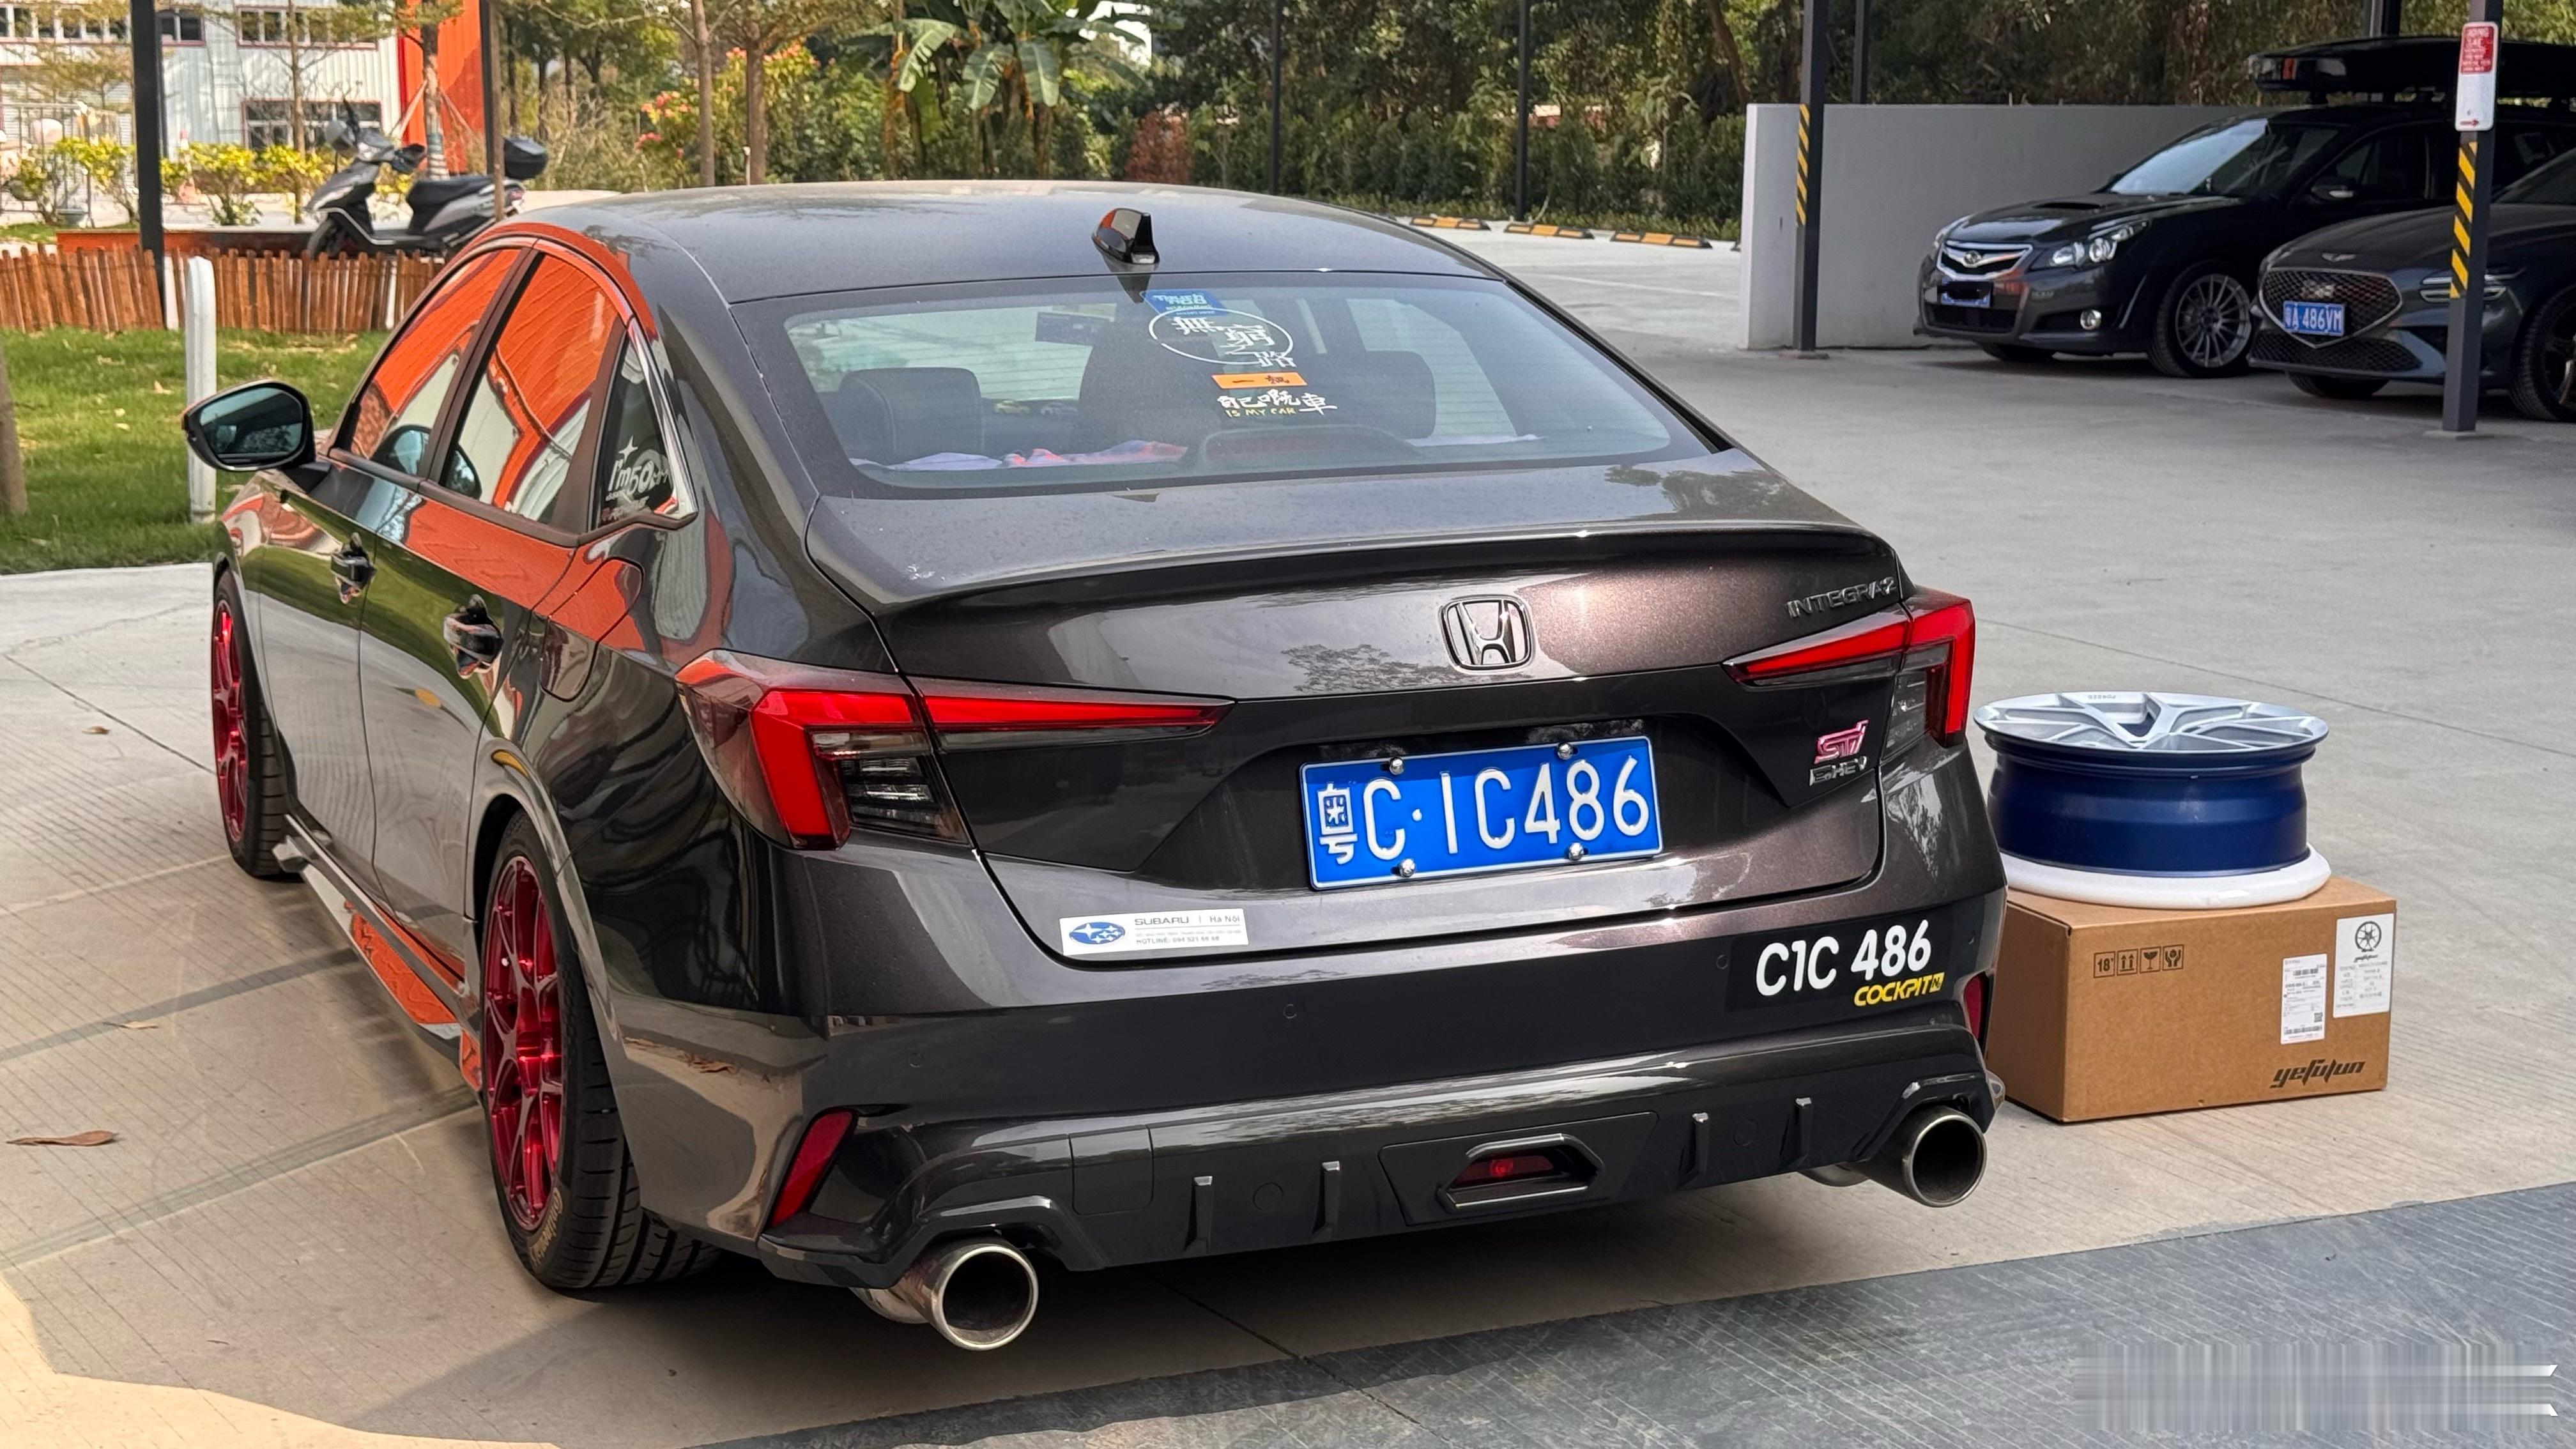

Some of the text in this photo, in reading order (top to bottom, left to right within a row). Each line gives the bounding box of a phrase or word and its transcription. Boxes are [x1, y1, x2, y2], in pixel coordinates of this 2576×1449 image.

[1245, 408, 1266, 417] MY
[1135, 916, 1189, 926] SUBARU
[1756, 919, 1932, 997] C1C 486
[1853, 975, 1933, 1008] COCKPIT
